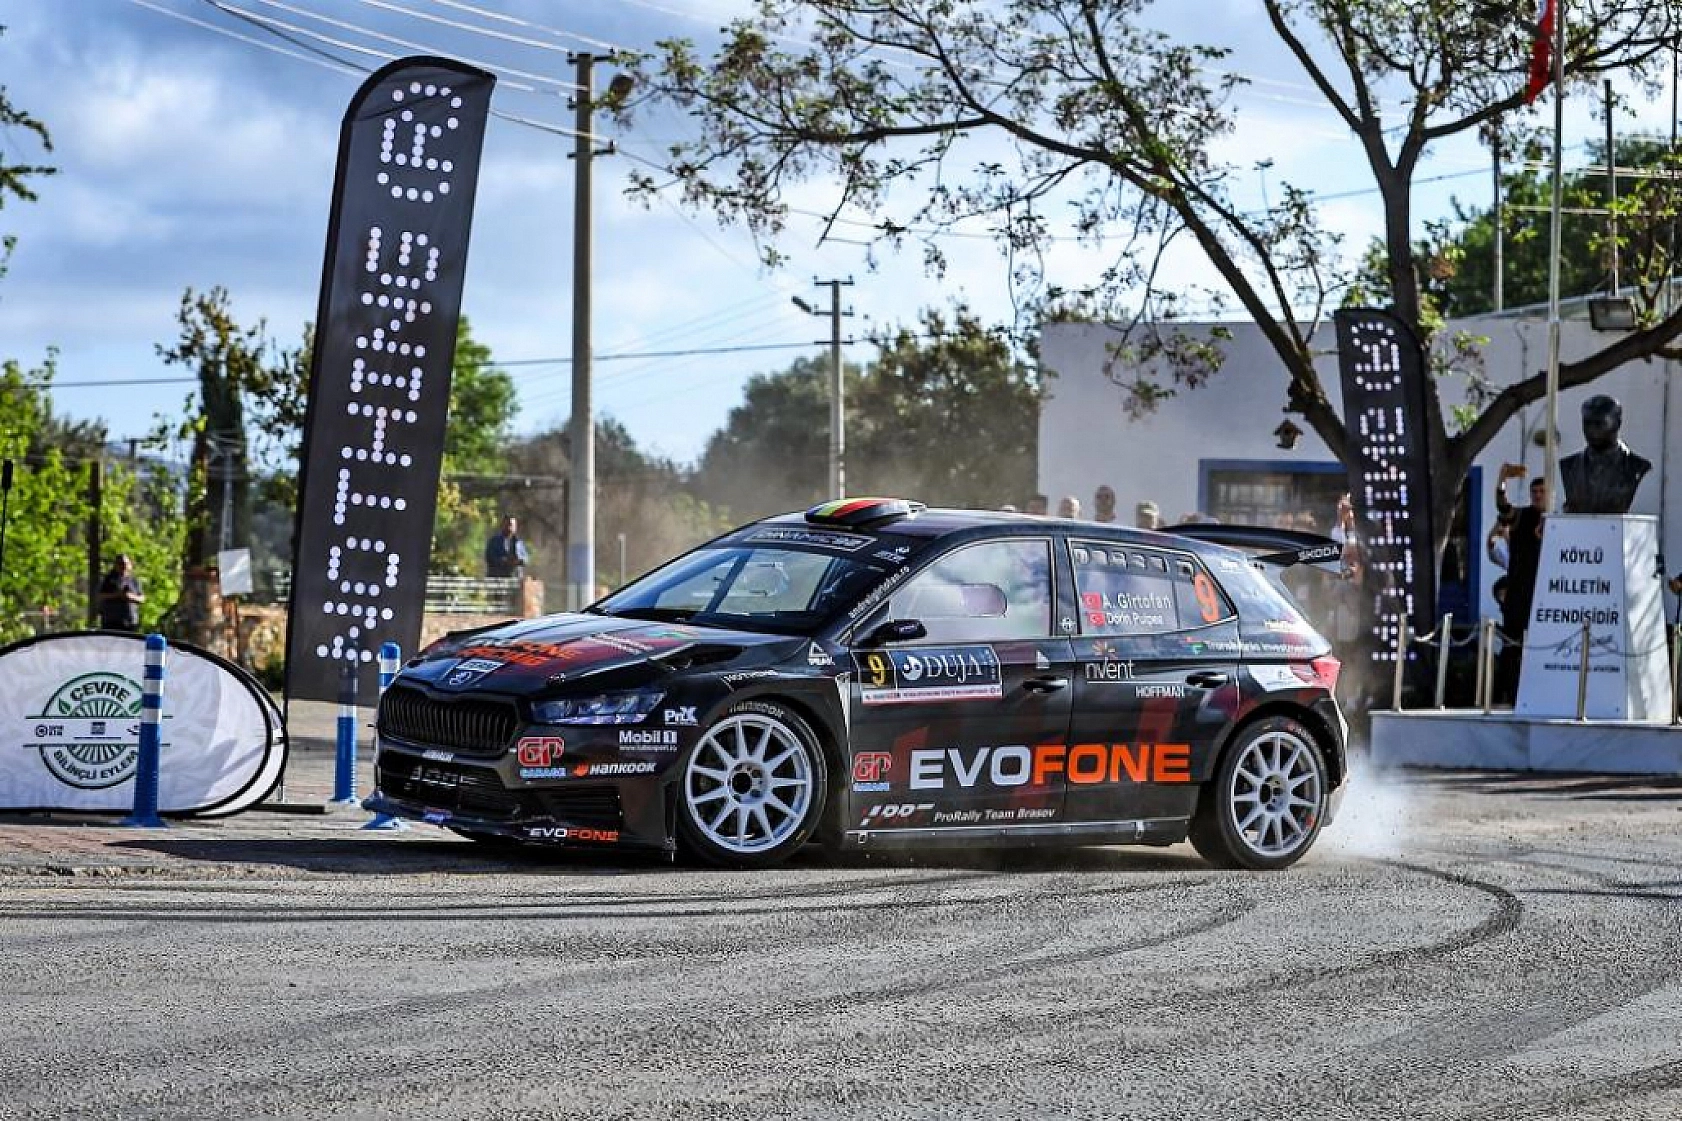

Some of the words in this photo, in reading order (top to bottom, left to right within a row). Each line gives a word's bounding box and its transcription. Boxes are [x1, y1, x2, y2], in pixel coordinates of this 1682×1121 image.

[316, 226, 439, 661] NOTHING
[1358, 407, 1417, 661] NOTHING
[1560, 546, 1603, 564] KÖYLÜ
[1548, 575, 1611, 595] MİLLETİN
[1103, 594, 1116, 609] A.
[1194, 572, 1220, 624] 9
[1535, 606, 1619, 625] EFENDİSİDİR
[867, 654, 886, 687] 9
[923, 654, 983, 683] DUJA
[1135, 685, 1185, 698] HOFFMAN
[619, 730, 661, 744] Mobil
[909, 742, 1190, 790] EVOFONE
[934, 810, 982, 823] ProRally
[984, 809, 1015, 820] Team
[1017, 807, 1055, 819] Brasov
[528, 827, 619, 842] EVOFONE
